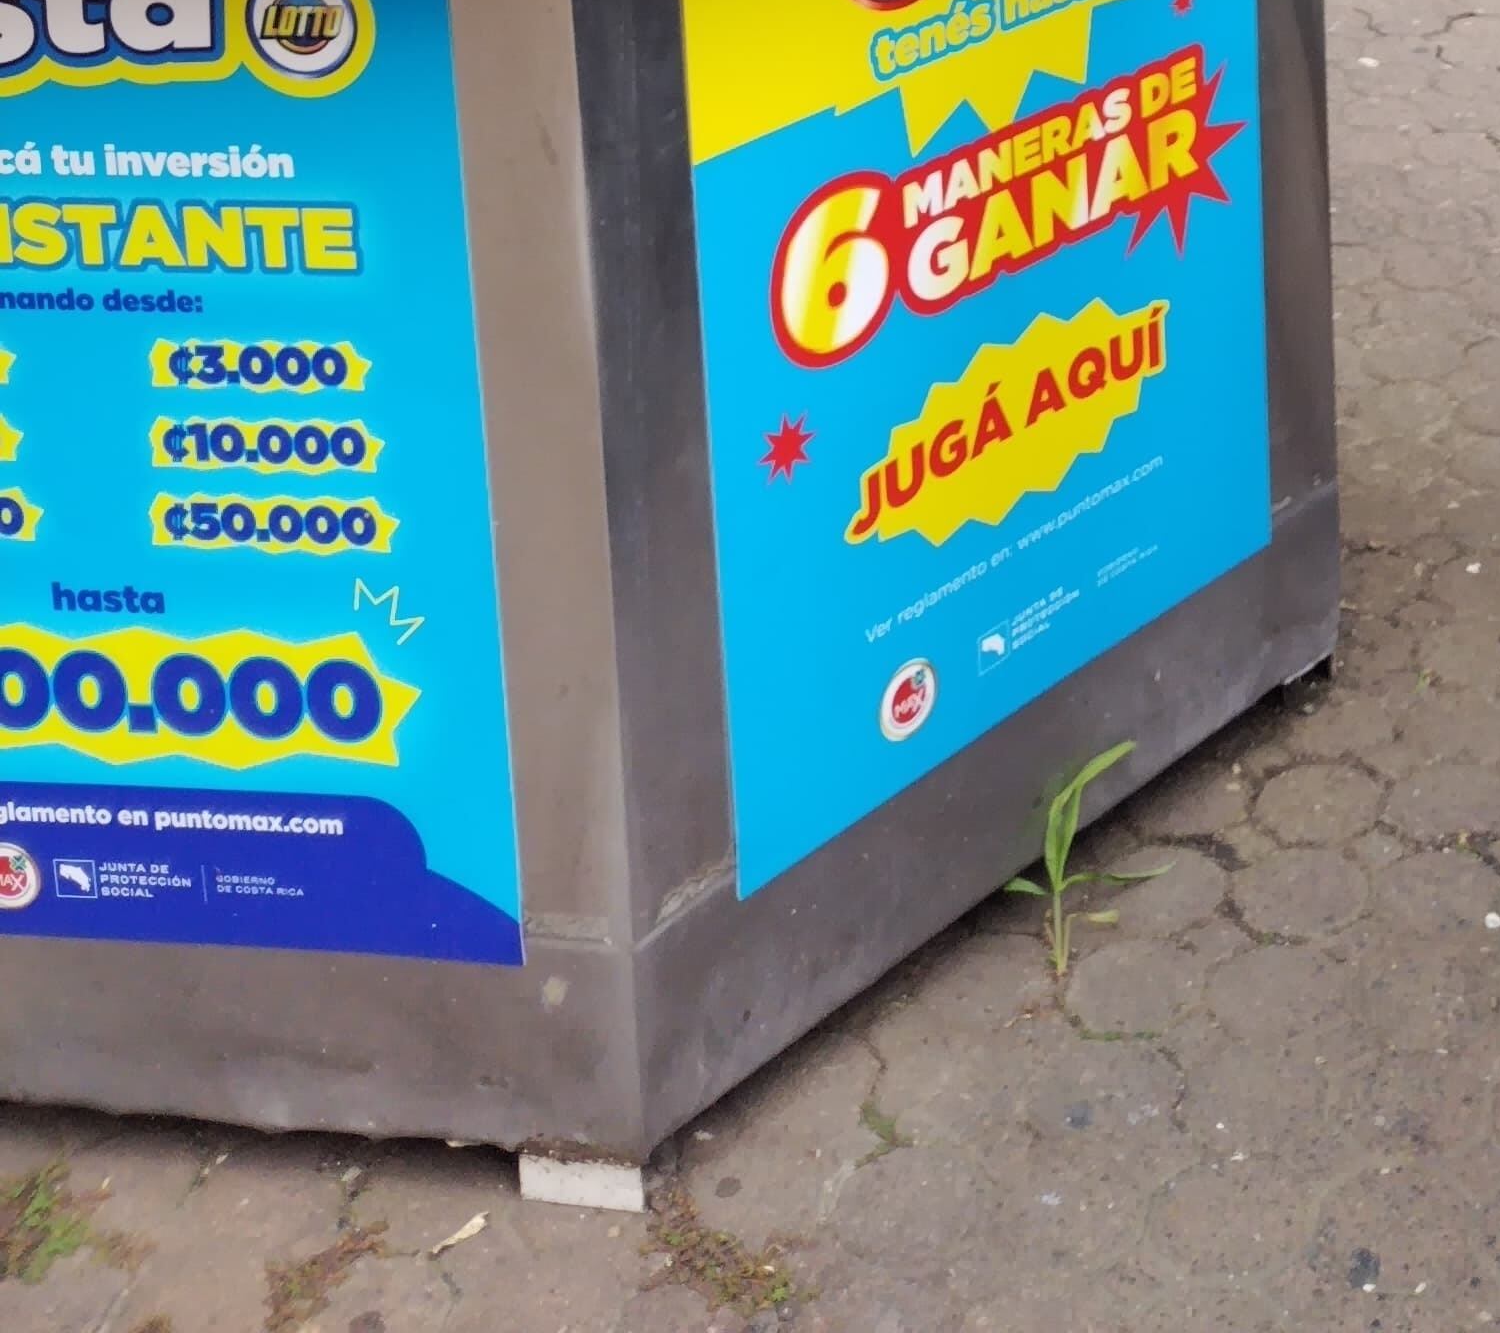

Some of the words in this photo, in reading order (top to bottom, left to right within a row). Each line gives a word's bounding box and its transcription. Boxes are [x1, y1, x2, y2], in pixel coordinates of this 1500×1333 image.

[261, 4, 345, 40] LOTTO
[51, 145, 96, 176] tu
[104, 143, 295, 179] inversión
[781, 187, 890, 355] 6
[903, 88, 1131, 229] MANERAS
[1140, 57, 1198, 120] DE
[906, 109, 1199, 302] GANAR
[0, 202, 358, 270] STANTE
[102, 289, 203, 314] desde:
[852, 381, 1014, 537] JUGÁ
[1025, 305, 1165, 428] AQUÍ
[865, 618, 894, 644] Ver
[898, 560, 988, 625] reglamento
[1016, 455, 1164, 550] www.puntomax.com
[51, 582, 166, 616] hasta
[117, 808, 149, 827] en
[154, 809, 344, 835] puntomax.com
[99, 861, 146, 874] JUNTA
[150, 863, 169, 874] DE
[100, 873, 192, 888] PROTECCIÓN
[216, 874, 276, 886] GOBIERNO
[100, 885, 154, 898] SOCIAL
[216, 884, 232, 894] DE
[235, 885, 274, 895] COSTA
